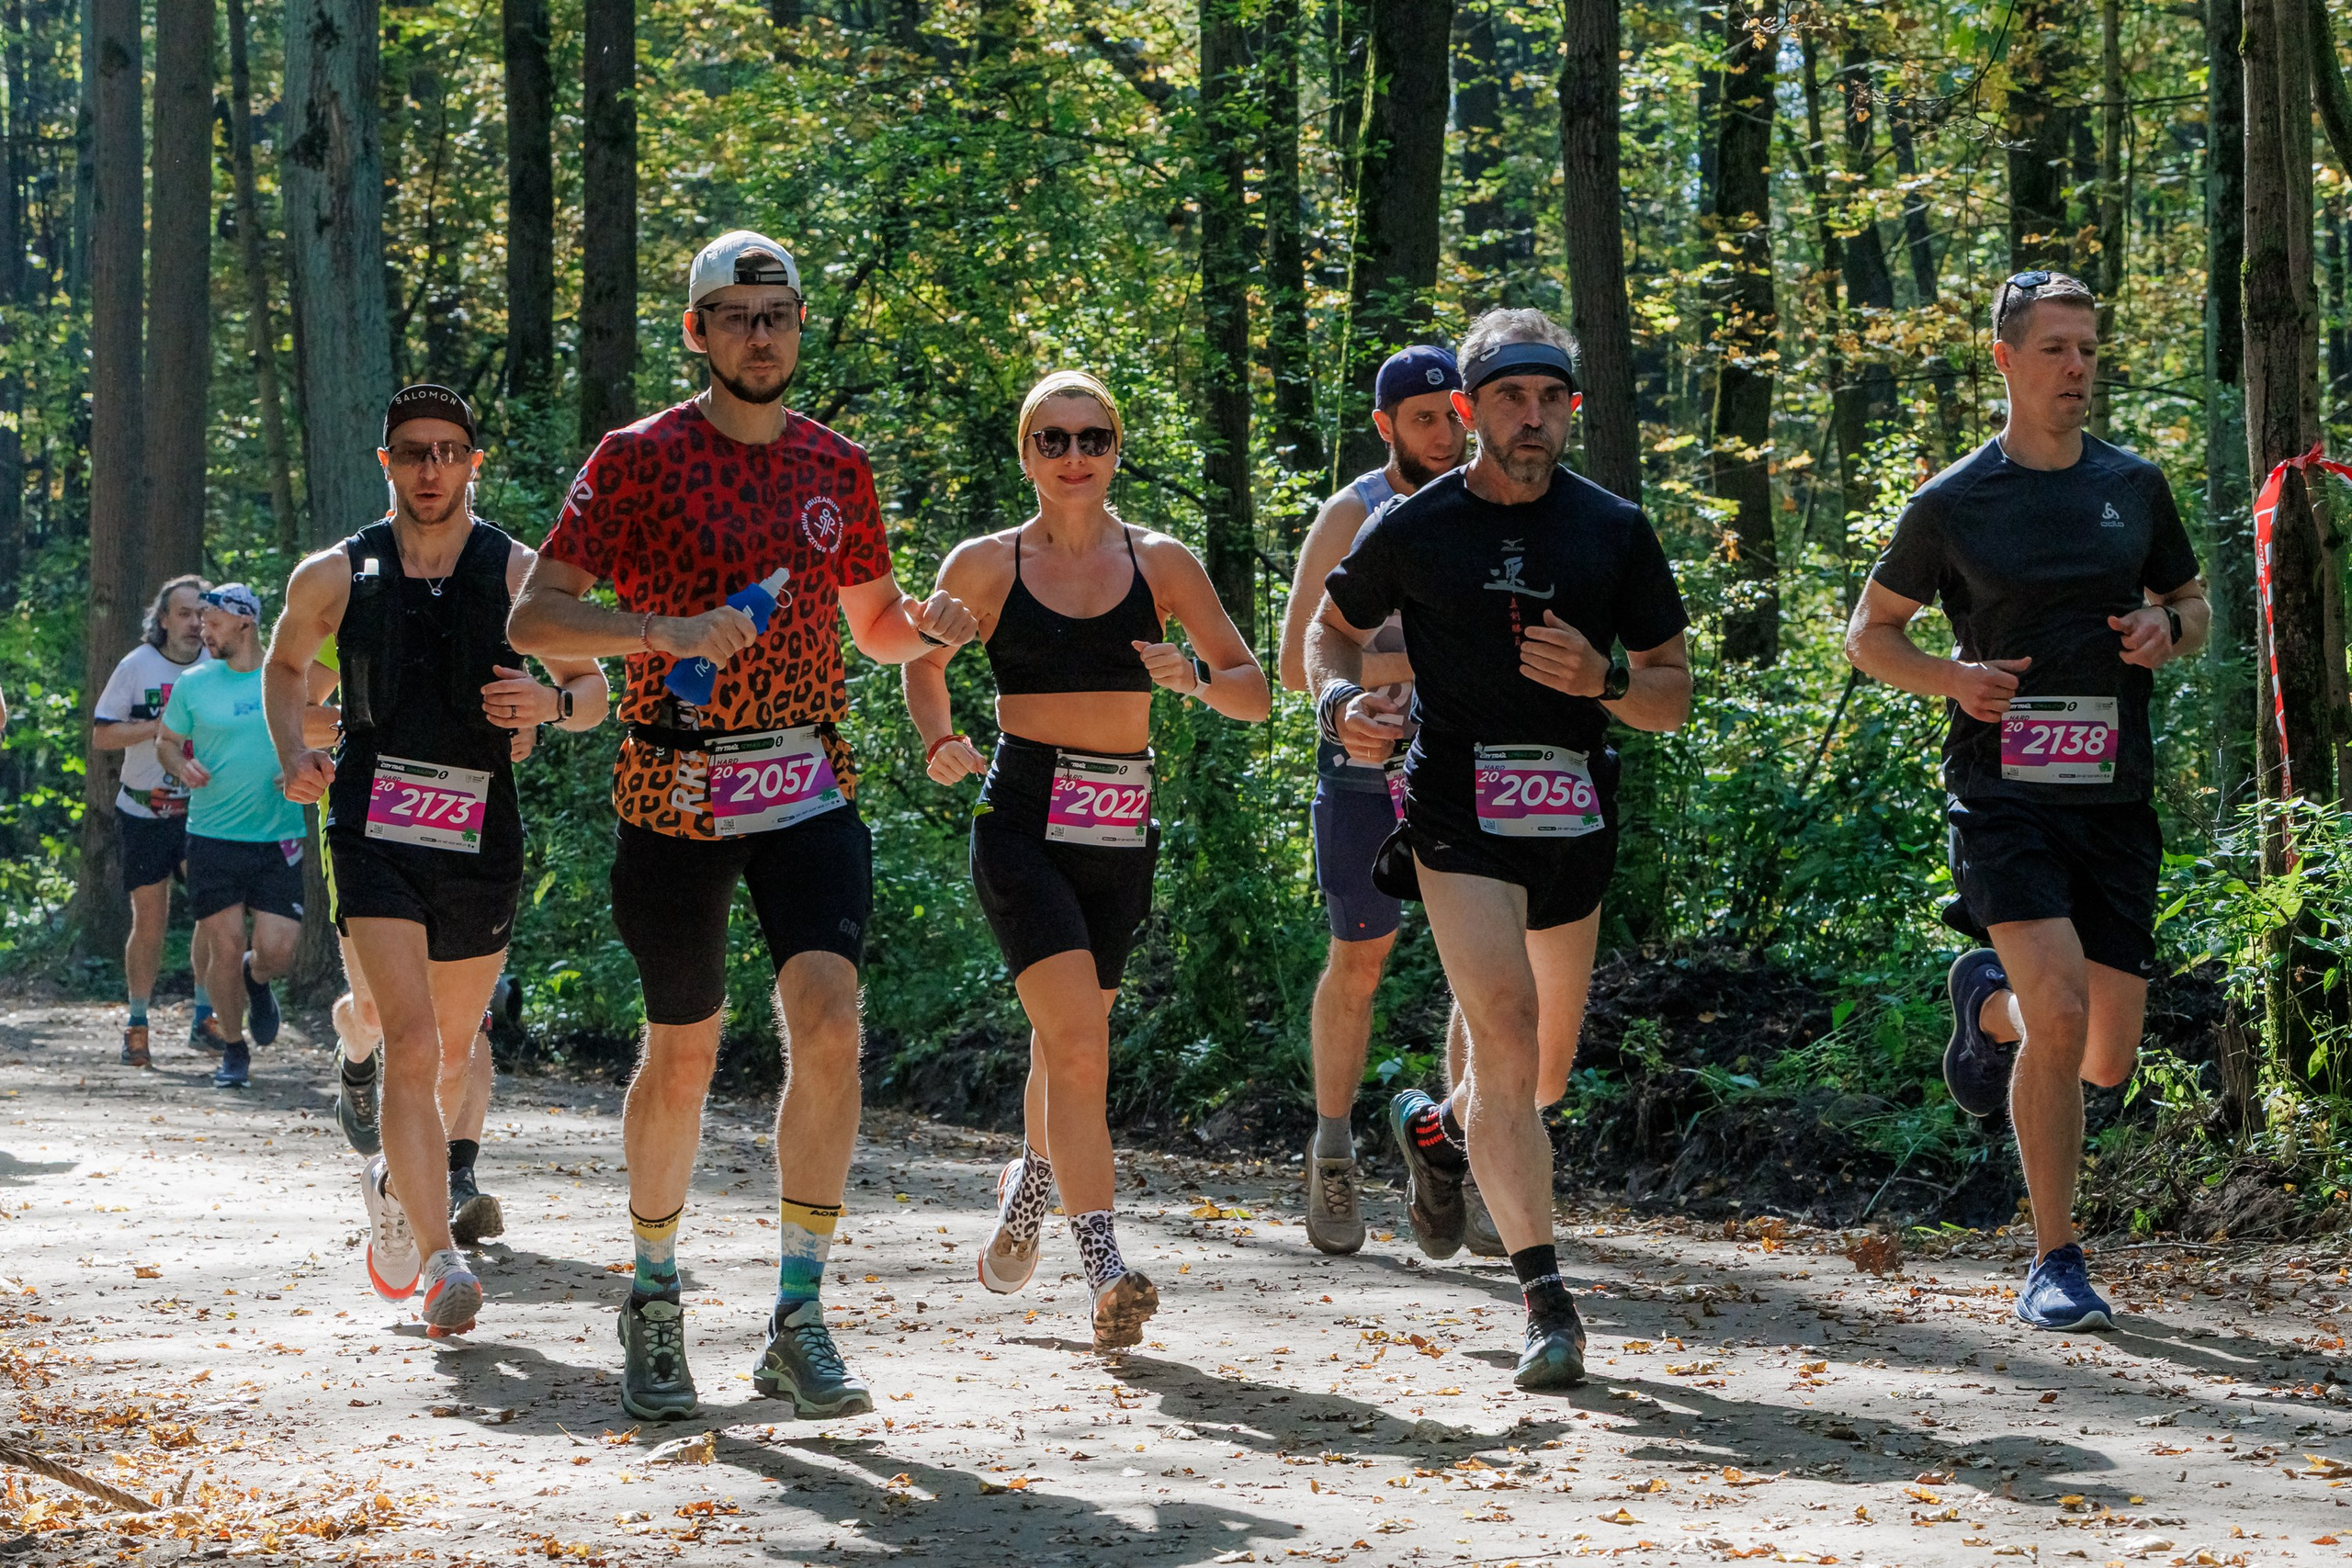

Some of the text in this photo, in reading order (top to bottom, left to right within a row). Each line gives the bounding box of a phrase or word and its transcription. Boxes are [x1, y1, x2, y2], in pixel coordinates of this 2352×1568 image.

[395, 390, 458, 406] SALOMON
[2004, 721, 2024, 733] 20
[2021, 725, 2109, 756] 2138
[717, 758, 739, 766] HARD
[712, 765, 733, 780] 20
[729, 756, 823, 803] 2057
[1478, 771, 1499, 783] 20
[375, 780, 395, 792] 20
[1055, 779, 1076, 792] 20
[1491, 774, 1592, 808] 2056
[390, 788, 478, 824] 2173
[1065, 785, 1148, 818] 2022
